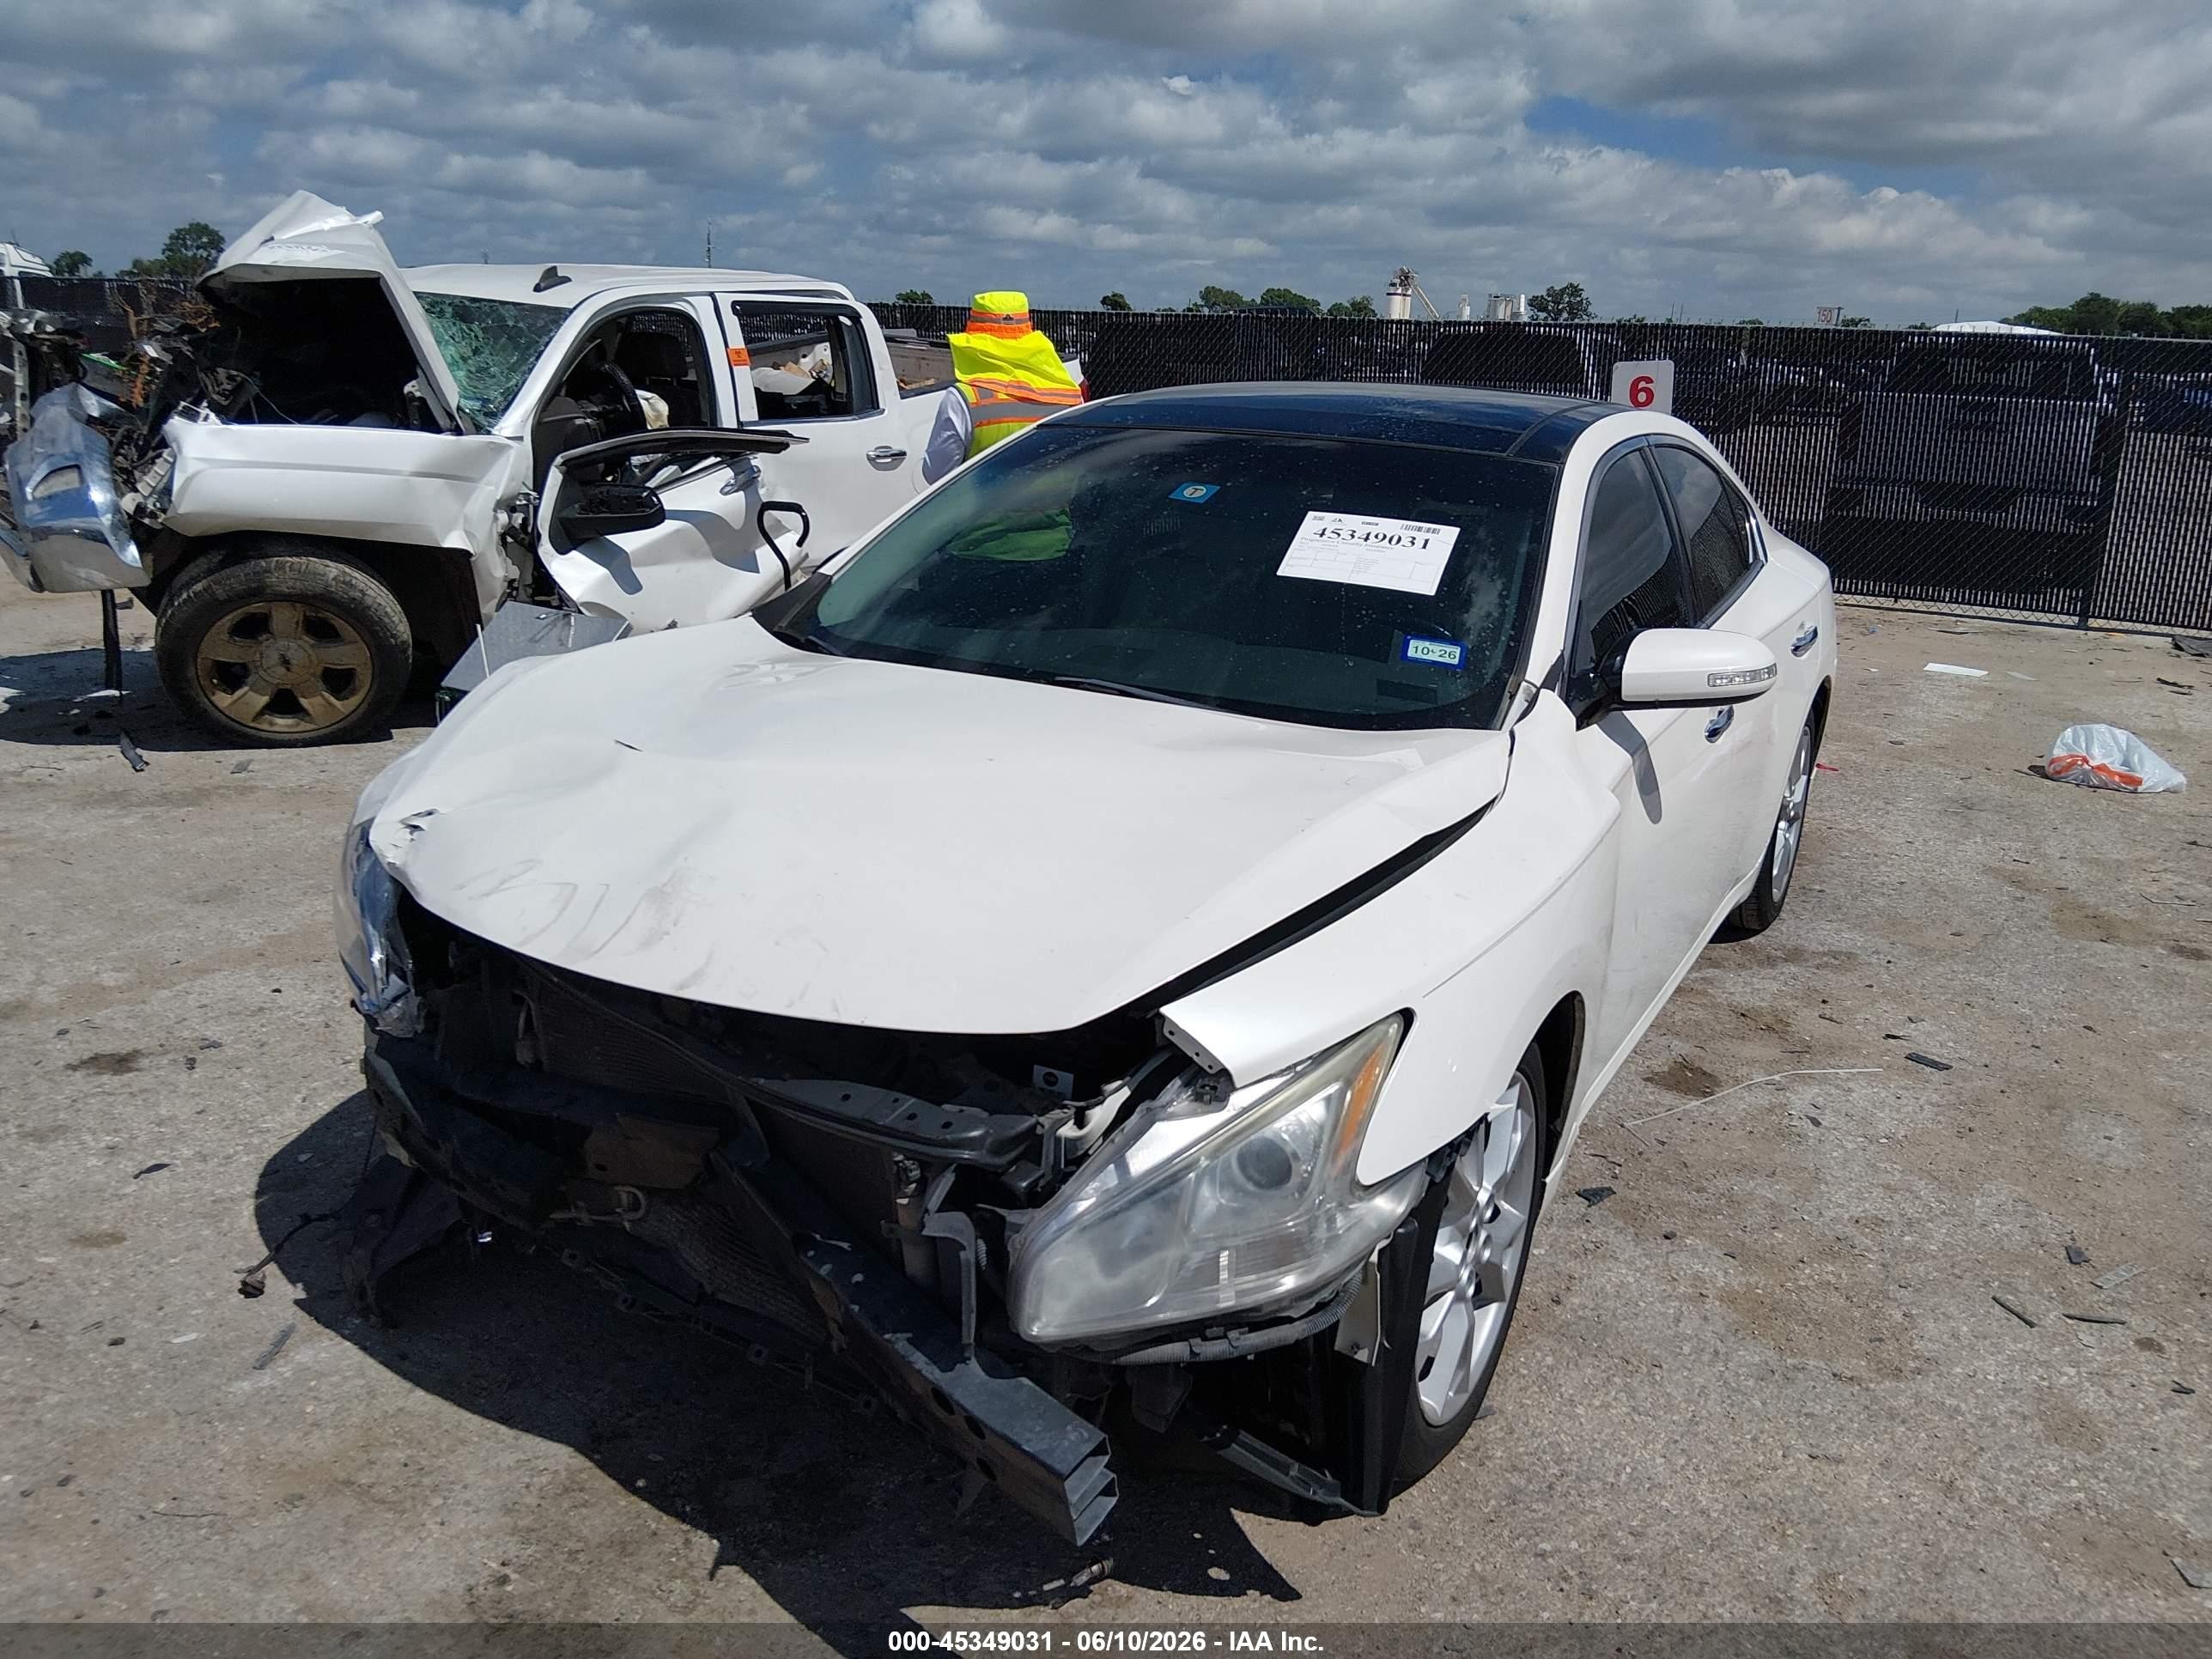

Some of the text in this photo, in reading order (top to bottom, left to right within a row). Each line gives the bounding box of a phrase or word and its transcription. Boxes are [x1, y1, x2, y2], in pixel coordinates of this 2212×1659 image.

[1817, 308, 1832, 323] 150
[1629, 375, 1655, 408] 6
[1312, 526, 1431, 550] 45349031
[1437, 648, 1457, 659] 26
